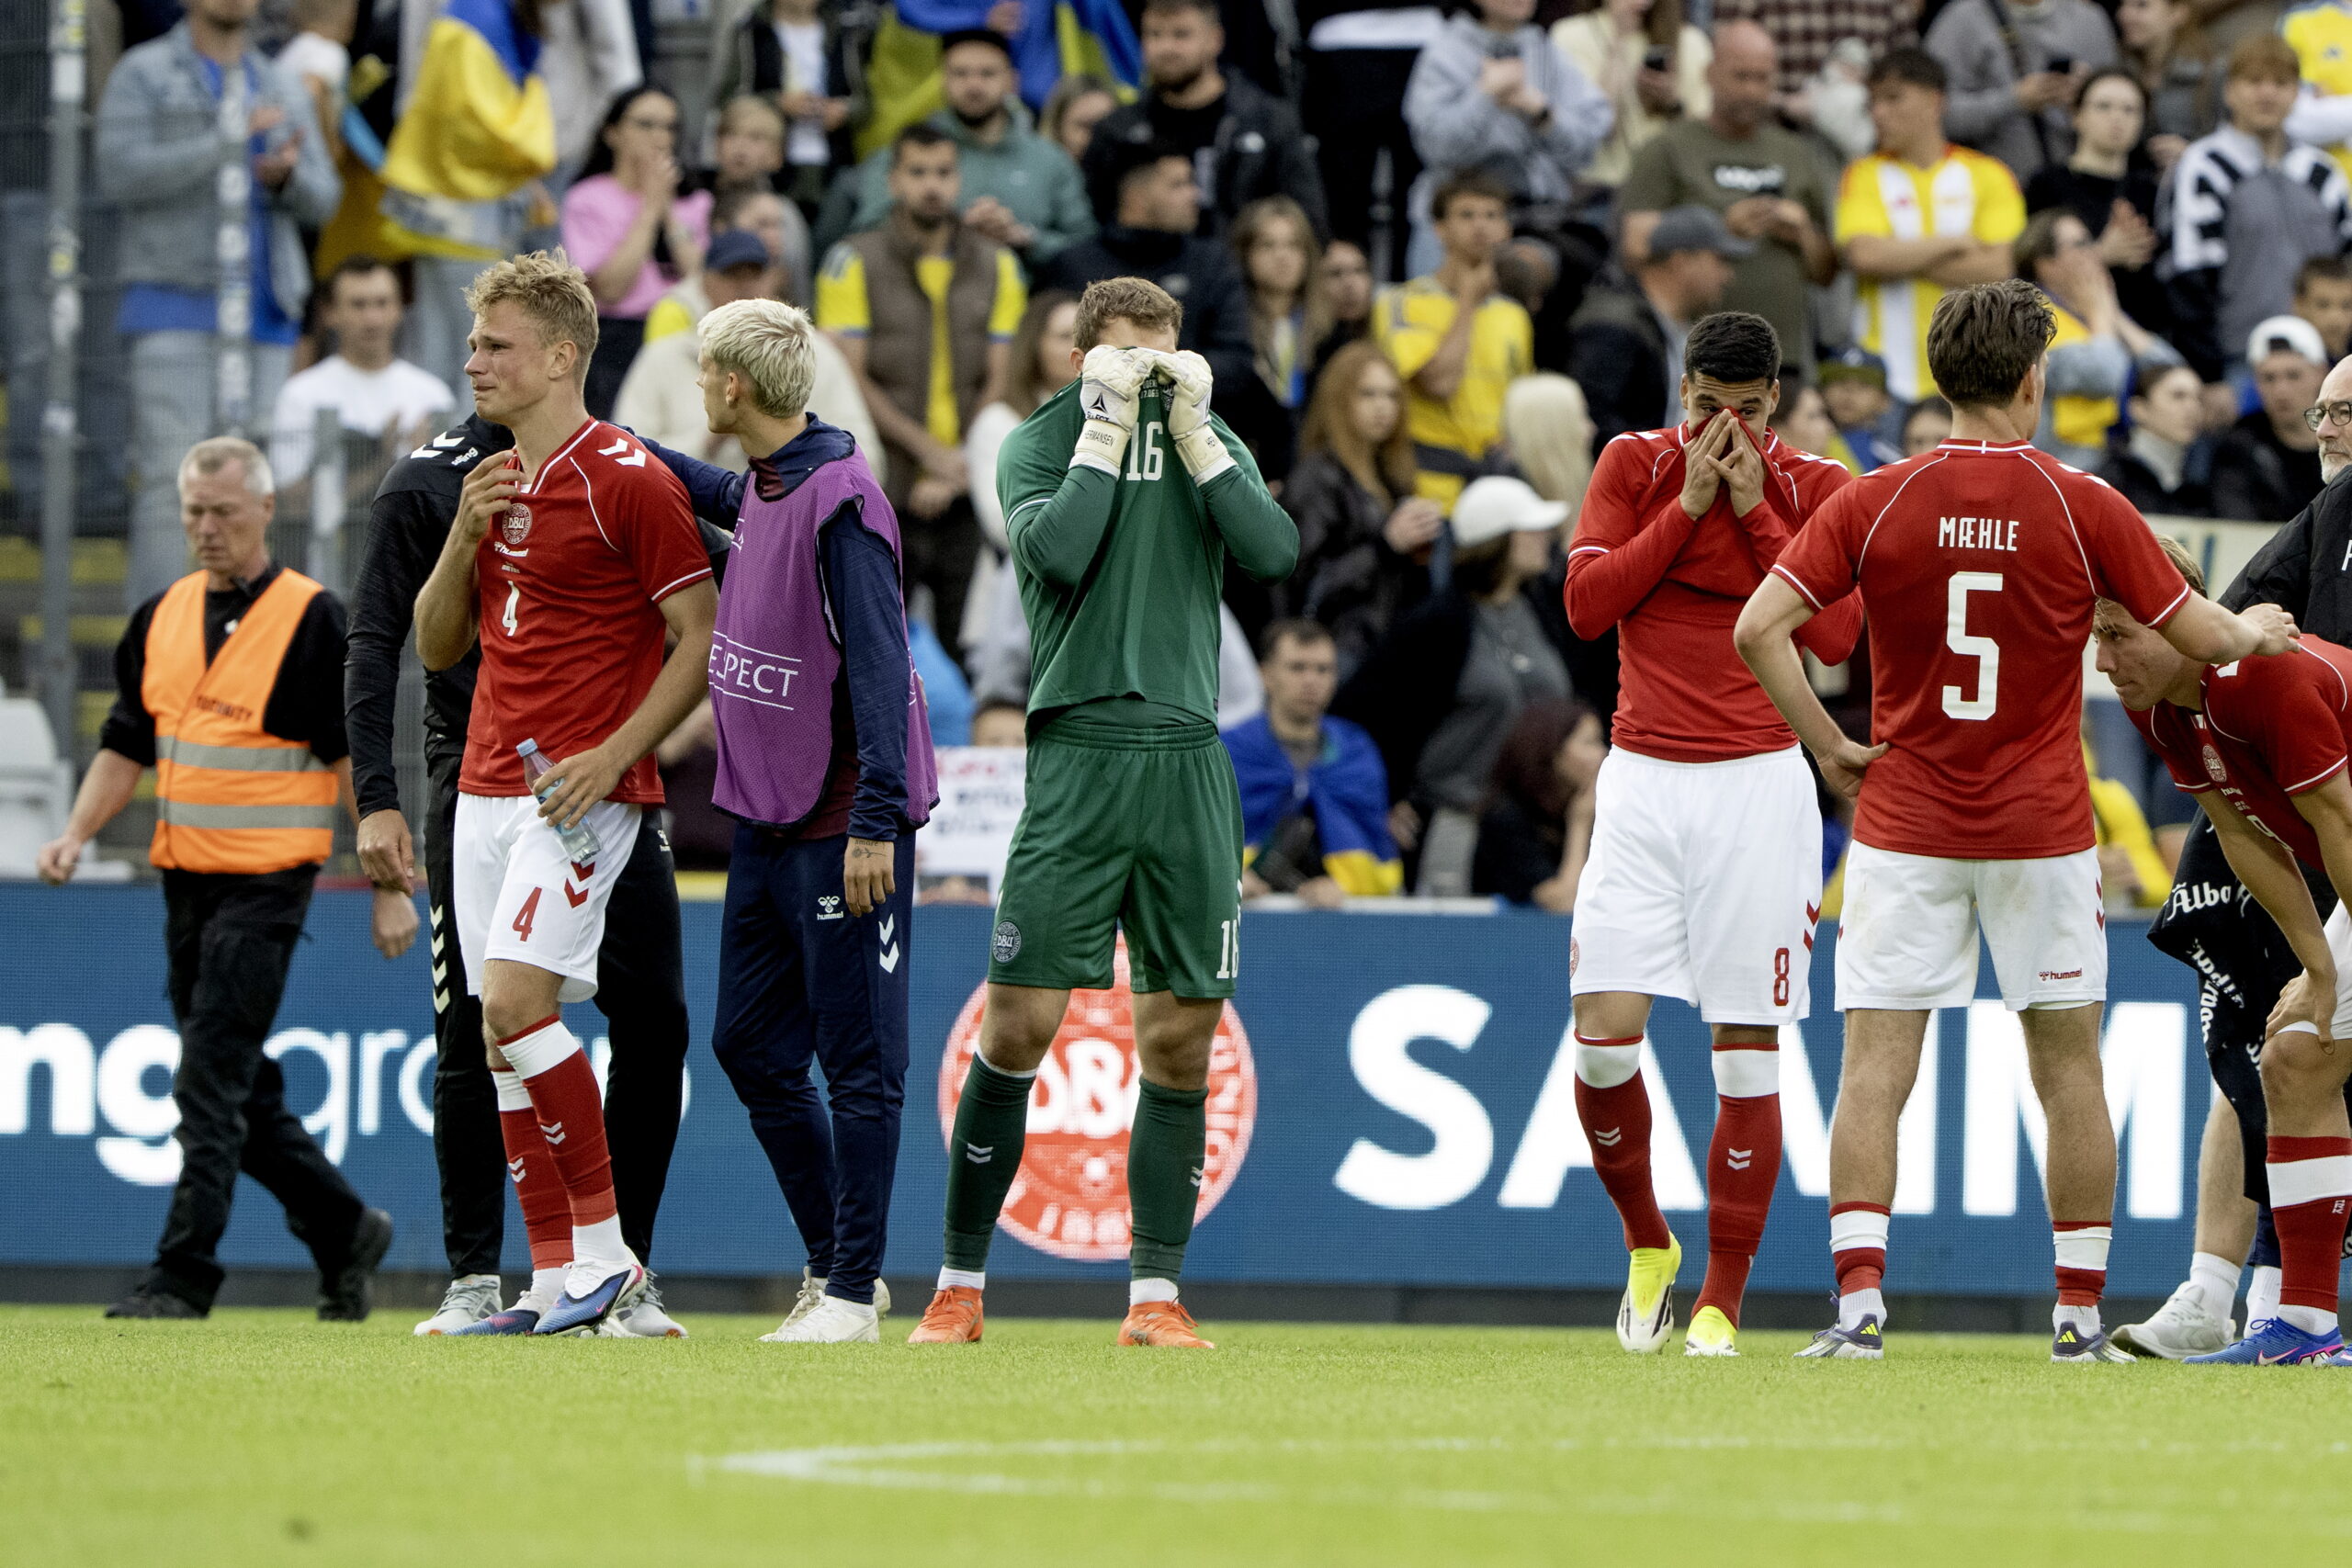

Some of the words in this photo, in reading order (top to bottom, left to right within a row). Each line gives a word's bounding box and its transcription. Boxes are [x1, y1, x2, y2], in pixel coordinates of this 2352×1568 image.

[1126, 421, 1164, 481] 16
[508, 516, 525, 530] DBU
[1939, 516, 2019, 552] MÆHLE
[502, 580, 520, 637] 4
[1941, 570, 2004, 720] 5
[512, 886, 543, 942] 4
[817, 911, 844, 920] hummel
[997, 934, 1014, 948] DBU
[1773, 947, 1790, 1007] 8
[2050, 967, 2083, 980] hummel
[1026, 1039, 1142, 1137] DB
